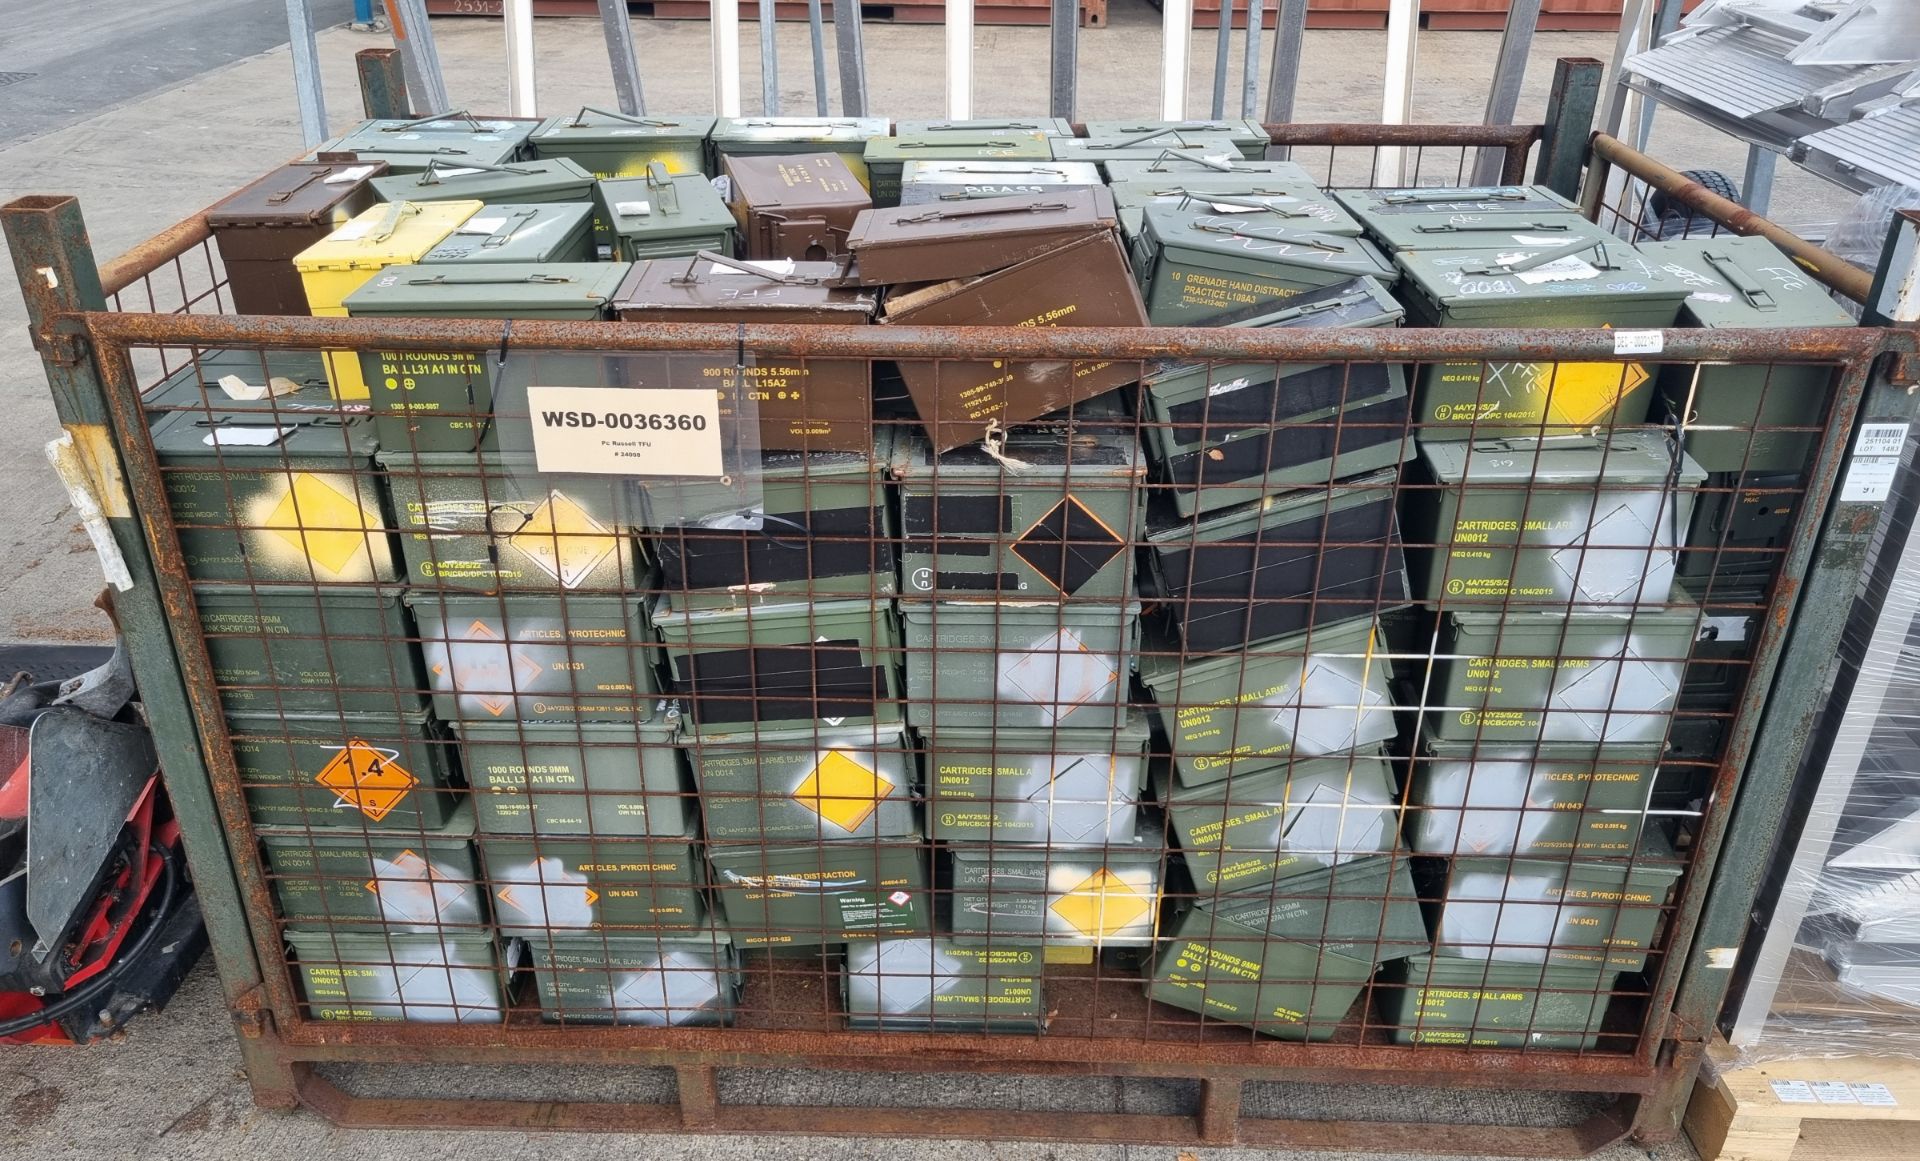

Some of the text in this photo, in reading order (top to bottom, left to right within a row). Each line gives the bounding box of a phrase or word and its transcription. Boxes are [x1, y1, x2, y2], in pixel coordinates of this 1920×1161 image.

[1171, 271, 1253, 293] 10 GRENADE HAND
[1184, 285, 1226, 300] PRACTICE
[1038, 304, 1077, 324] 5.56mm
[383, 364, 410, 375] BAL
[412, 364, 429, 375] L31
[432, 364, 444, 374] A1
[448, 364, 458, 374] IN
[703, 369, 721, 377] 900
[724, 368, 768, 376] RONDS
[723, 379, 787, 388] BAL L15A2
[1472, 375, 1480, 383] kg
[542, 412, 707, 431] WSD-0036360
[227, 472, 258, 481] SMALL
[1457, 521, 1519, 532] CARTRIDGES,
[1454, 533, 1489, 543] UN0012
[568, 630, 626, 638] YROTECHNIC
[552, 663, 565, 671] UN
[1468, 658, 1590, 669] CARTRIDGES, ARMS
[1467, 669, 1500, 679] UN002
[1235, 689, 1265, 705] MALL
[1180, 715, 1212, 729] UN0012
[488, 766, 507, 774] 1000
[549, 766, 570, 774] 9MM
[997, 767, 1026, 777] SMALL
[489, 776, 575, 784] BALL L3 A1 IN CTN
[940, 777, 970, 785] UN0012
[1578, 773, 1640, 782] PYOTECHNIC
[1244, 811, 1273, 826] SMALL
[1192, 833, 1222, 846] UN0012
[579, 864, 620, 872] ARTCLES,
[1008, 868, 1033, 877] SMALL
[1546, 889, 1588, 900] ARTCLES,
[1566, 917, 1599, 927] UN 0431
[1187, 942, 1261, 972] 1000 OUNDS 9MM
[1181, 950, 1259, 981] BALL A1 IN CTN
[312, 977, 339, 985] UN0012
[1004, 988, 1032, 996] UN0012
[1500, 992, 1524, 1001] ARMS
[954, 995, 980, 1003] SMALL
[1416, 999, 1445, 1007] U0012
